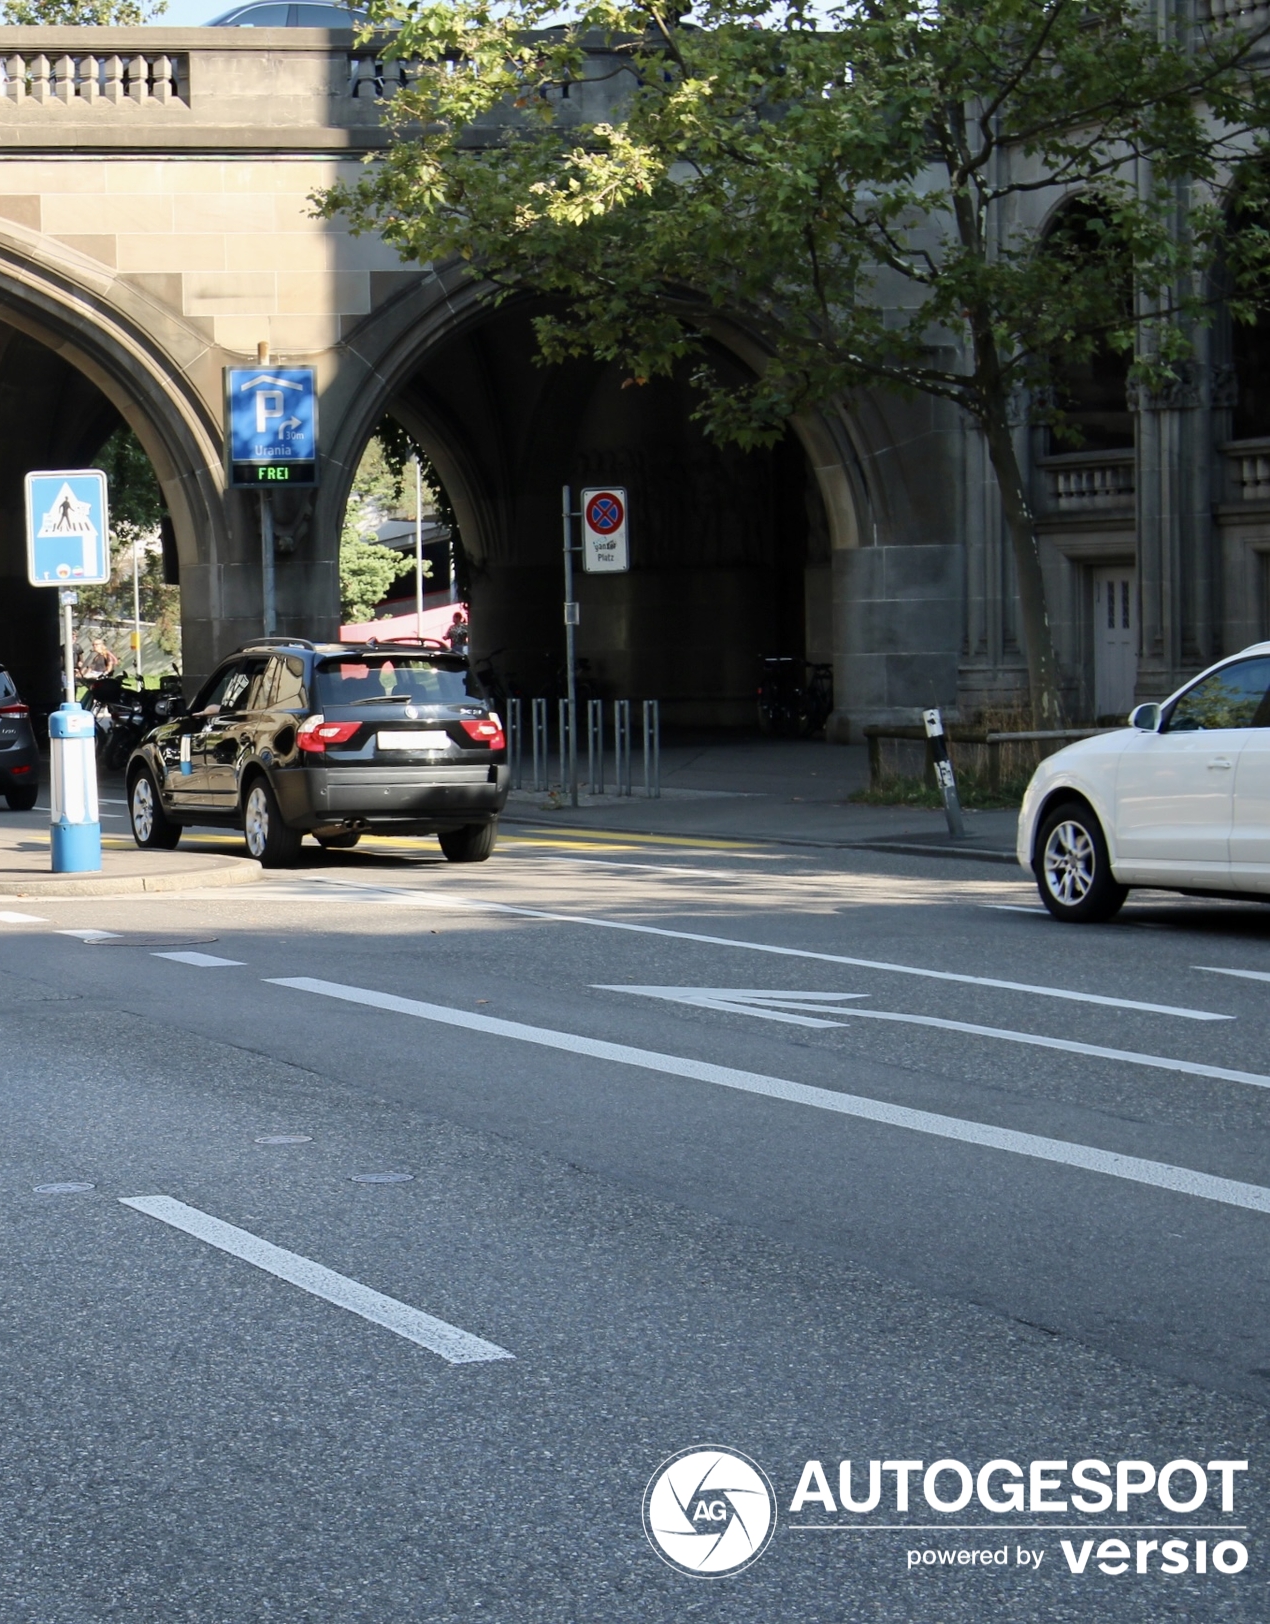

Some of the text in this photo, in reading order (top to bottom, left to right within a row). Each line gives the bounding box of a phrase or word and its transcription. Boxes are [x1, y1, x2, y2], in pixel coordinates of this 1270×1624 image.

[256, 390, 284, 433] P
[286, 431, 304, 440] 30m
[255, 445, 292, 456] Urania
[258, 467, 289, 480] FREI
[597, 553, 614, 561] Platz
